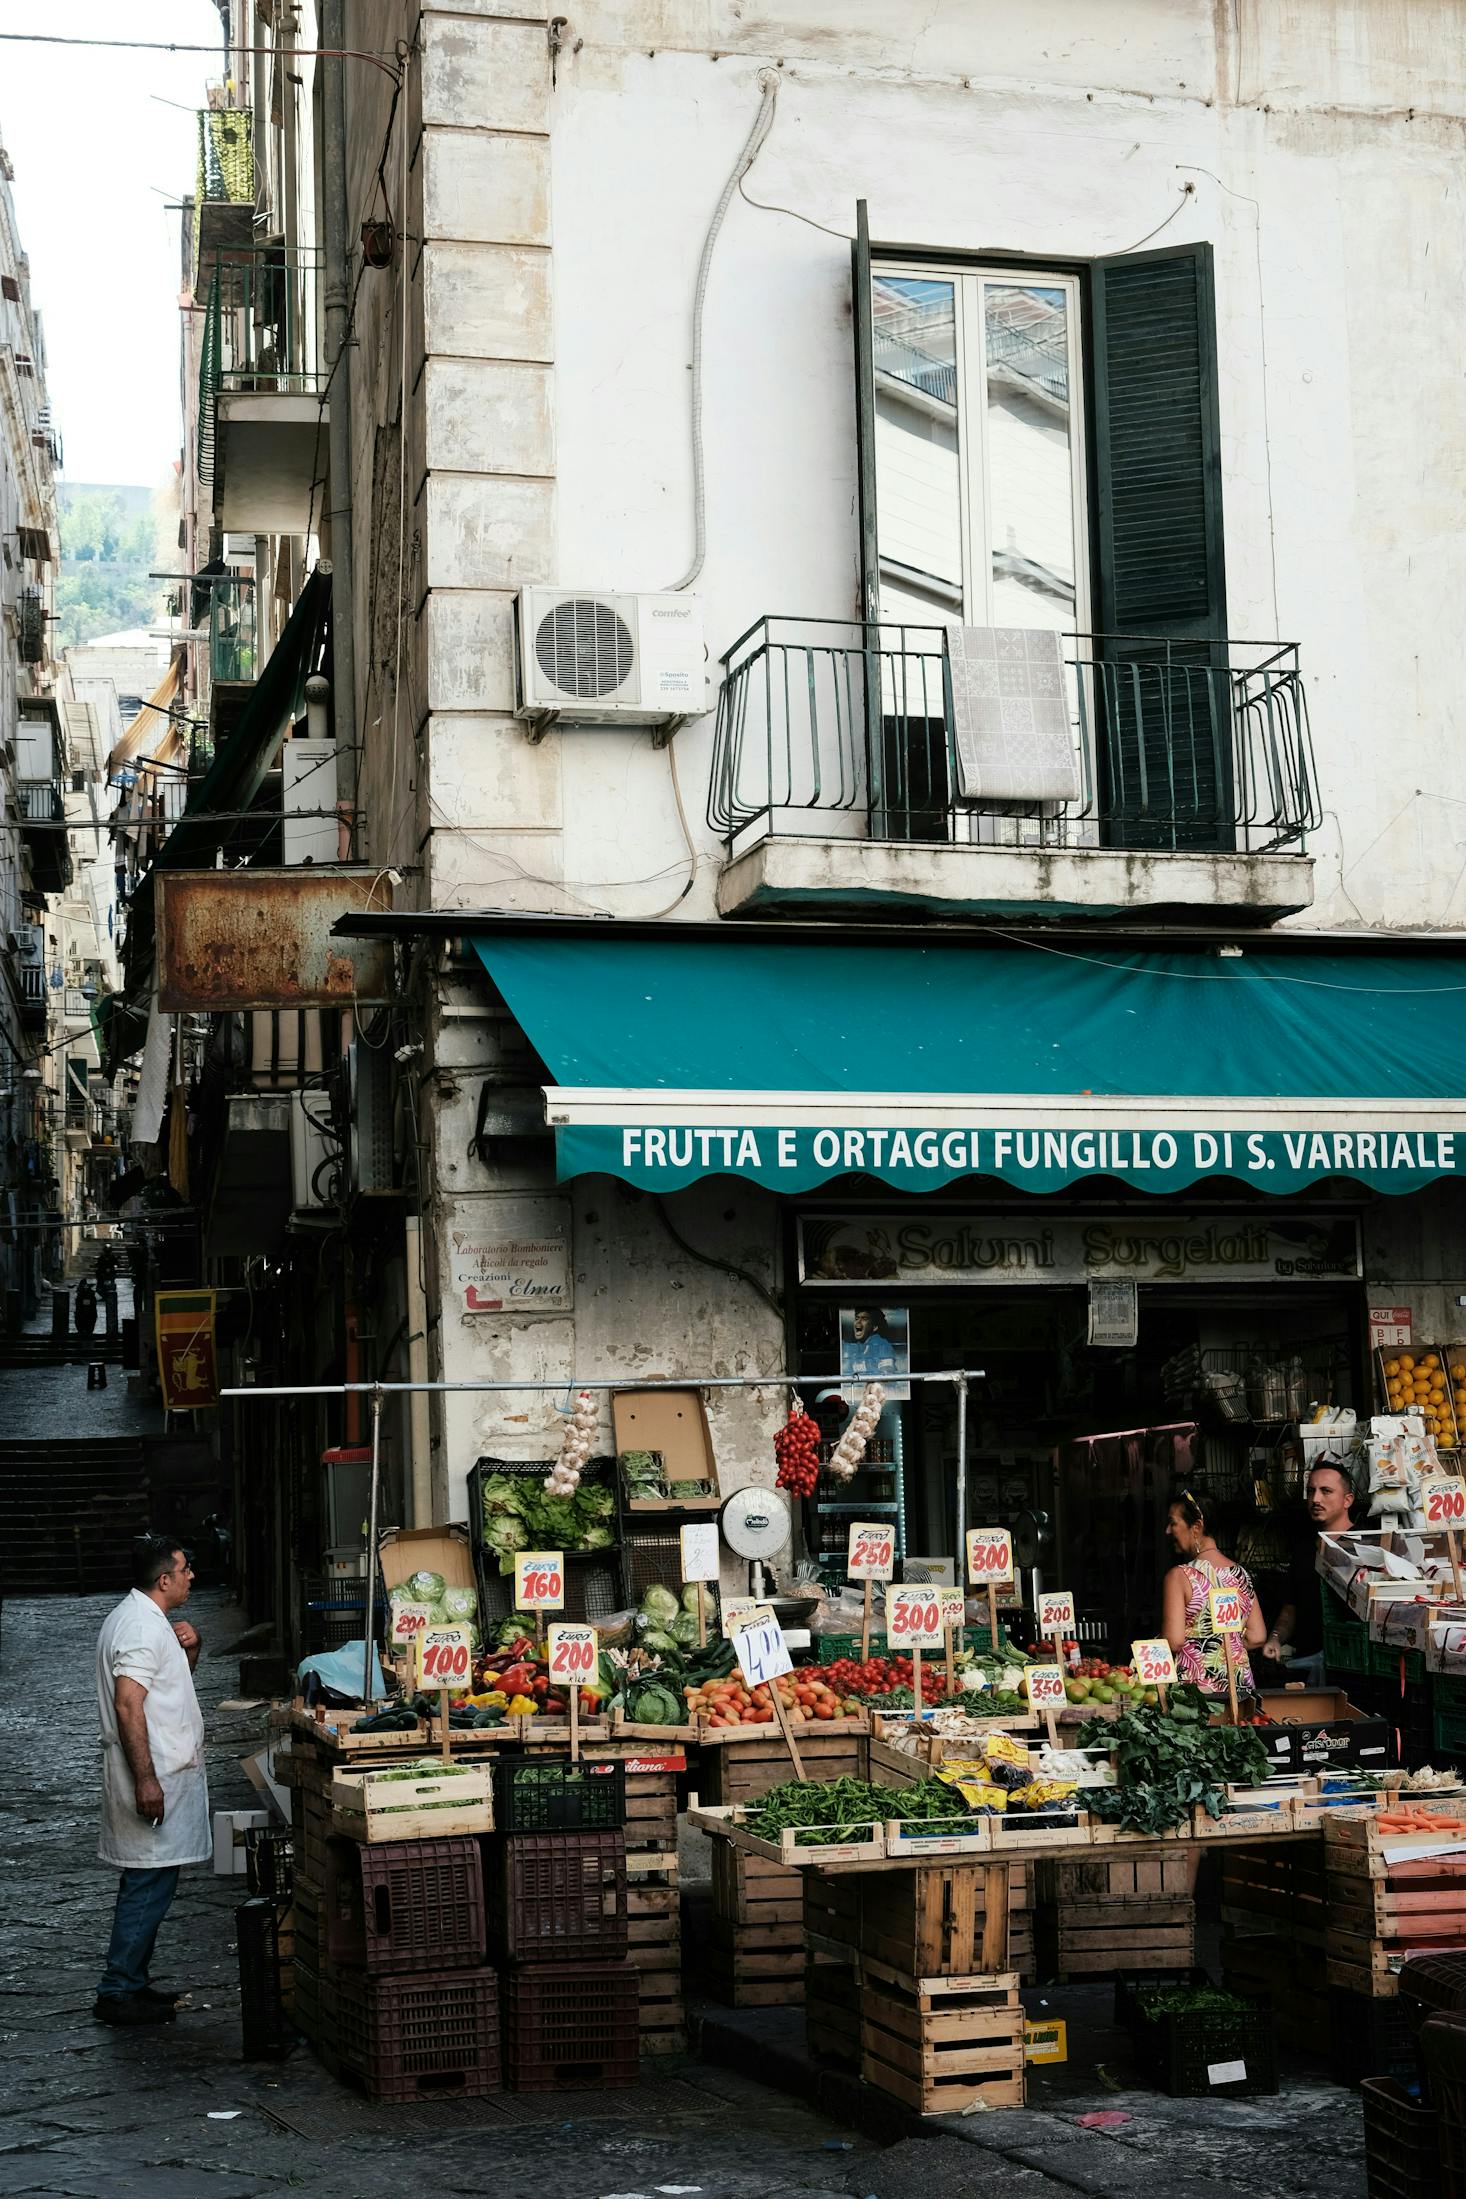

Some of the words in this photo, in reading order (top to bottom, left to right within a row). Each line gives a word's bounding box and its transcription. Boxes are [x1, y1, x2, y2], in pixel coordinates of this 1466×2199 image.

[623, 1129, 761, 1167] FRUTTA
[778, 1130, 797, 1167] E
[813, 1130, 980, 1168] ORTAGGI
[995, 1131, 1178, 1169] FUNGILLO
[1193, 1132, 1232, 1168] DI
[1247, 1133, 1275, 1170] S.
[1283, 1133, 1456, 1170] VARRIALE
[456, 1245, 509, 1255] Laboratorio
[511, 1242, 563, 1253] Bomboniere
[898, 1225, 1055, 1269] Salumi
[1084, 1223, 1270, 1277] Surgelati
[473, 1258, 506, 1268] Articoli
[508, 1259, 519, 1267] da
[521, 1257, 548, 1269] regalo
[458, 1272, 511, 1282] Creazioni
[509, 1278, 562, 1296] Elma
[1373, 1311, 1389, 1319] QUI
